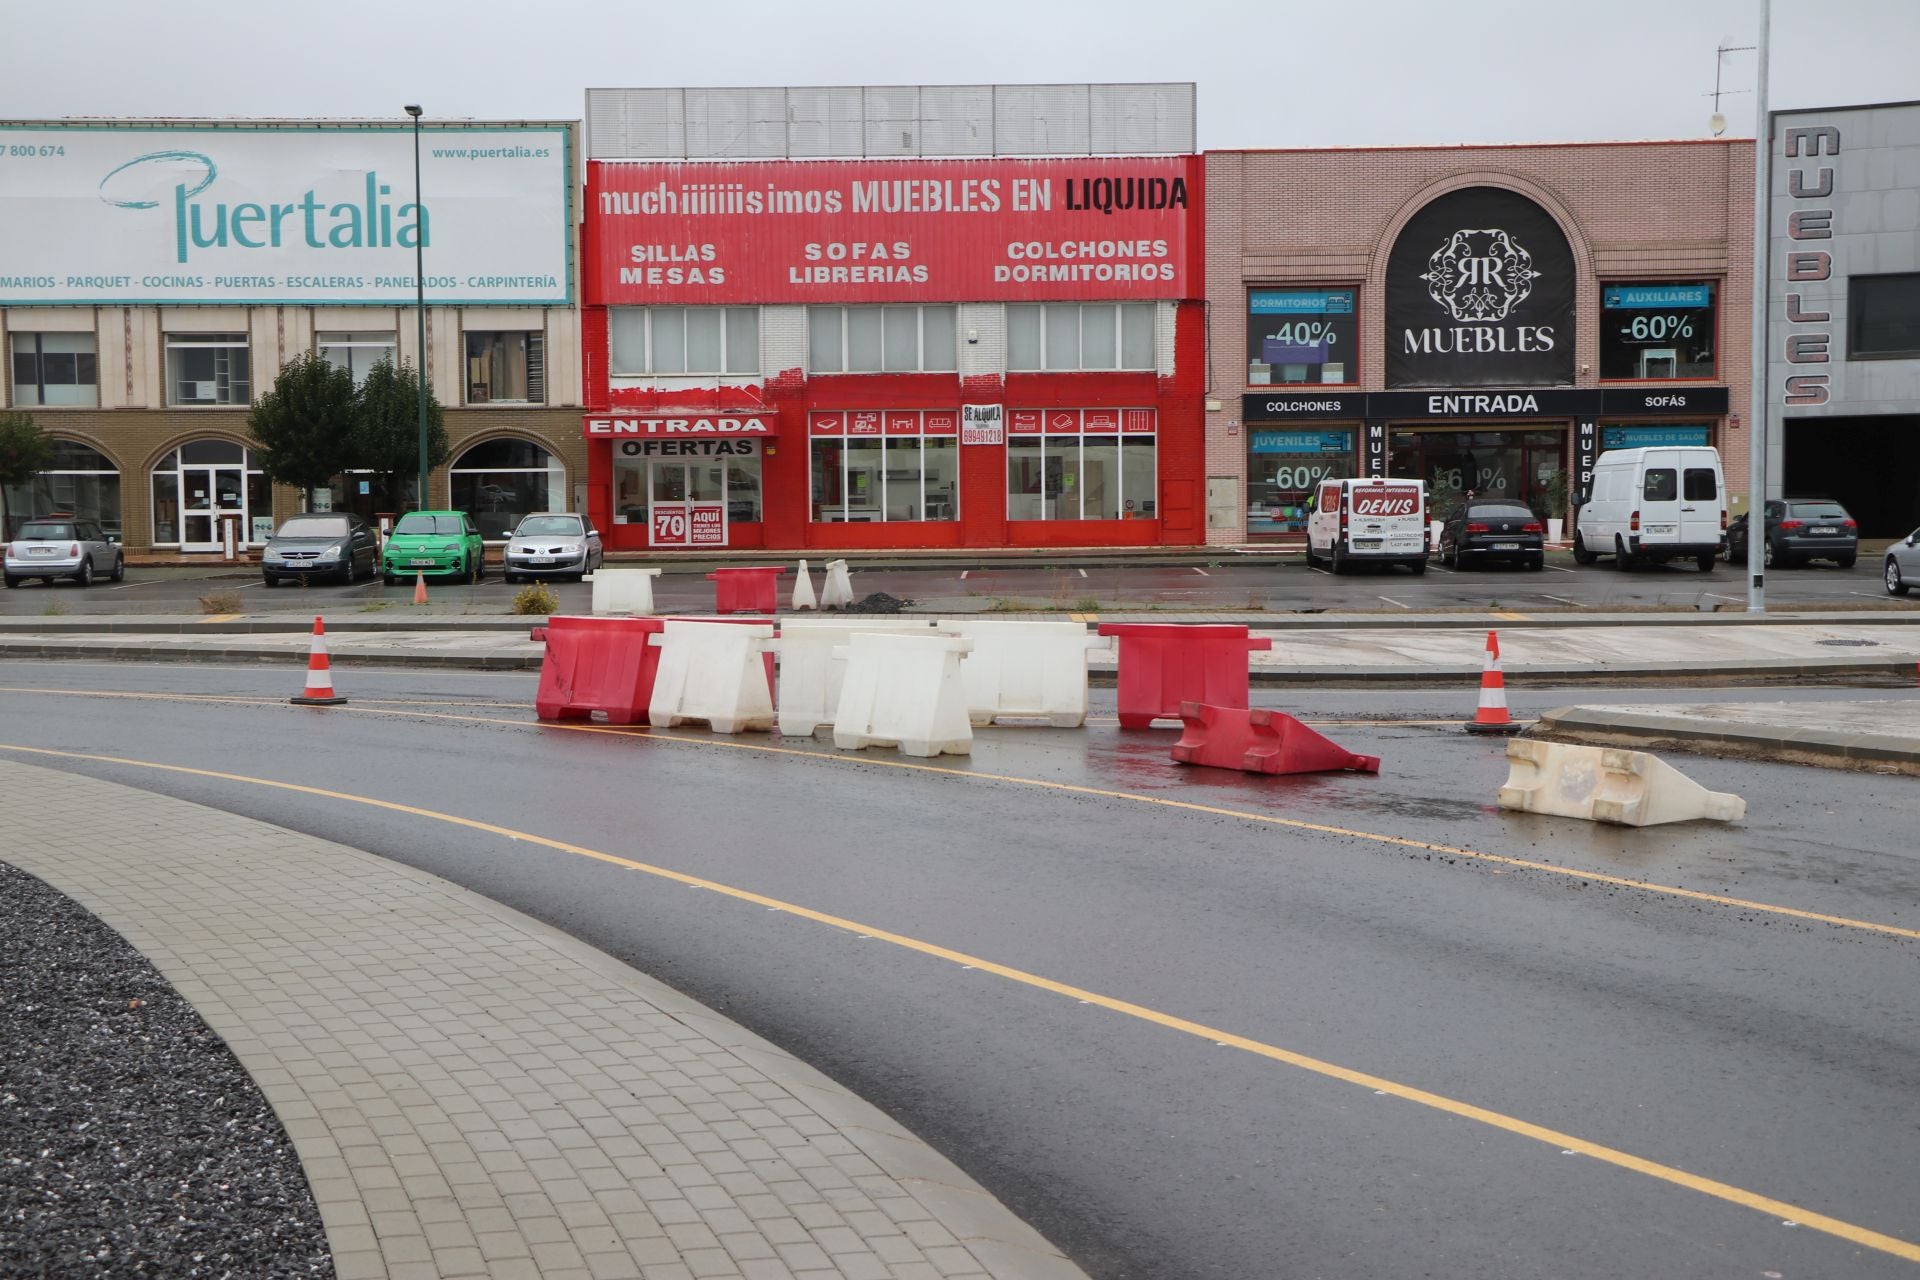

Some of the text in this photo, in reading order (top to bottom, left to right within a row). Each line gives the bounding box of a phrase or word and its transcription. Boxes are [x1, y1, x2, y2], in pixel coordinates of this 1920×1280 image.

[10, 145, 36, 157] 800
[39, 145, 65, 157] 674
[432, 146, 550, 160] www.puertalia.es
[852, 179, 1000, 213] MUEBLES
[1012, 179, 1051, 212] EN
[1066, 177, 1187, 215] LIQUIDA
[100, 150, 430, 263] Puertalia
[631, 244, 716, 262] SILLAS
[805, 242, 911, 260] SOFAS
[1007, 240, 1168, 259] COLCHONES
[789, 265, 929, 283] LIBRERIAS
[994, 264, 1175, 282] DORMITORIOS
[1784, 125, 1840, 407] MUEBLES
[67, 276, 131, 289] PARQUET
[142, 276, 204, 288] COCINAS
[215, 276, 275, 288] PUERTAS
[287, 276, 364, 288] ESCALERAS
[375, 276, 457, 288] PANELADOS
[468, 274, 557, 288] CARPINTERÍA
[620, 267, 725, 285] MESAS
[1252, 298, 1326, 308] DORMITORIOS
[1626, 292, 1703, 303] AUXILIARES
[1266, 322, 1337, 345] -40%
[1621, 315, 1693, 340] -60%
[1405, 327, 1555, 354] MUEBLES
[1266, 401, 1342, 412] COLCHONES
[1428, 395, 1539, 414] ENTRADA
[1645, 395, 1686, 407] SOFÁS
[964, 406, 1001, 423] SE ALQUILA
[589, 418, 767, 434] ENTRADA
[621, 440, 753, 456] OFERTAS
[1253, 436, 1321, 448] JUVENILES
[1357, 499, 1413, 514] DENIS
